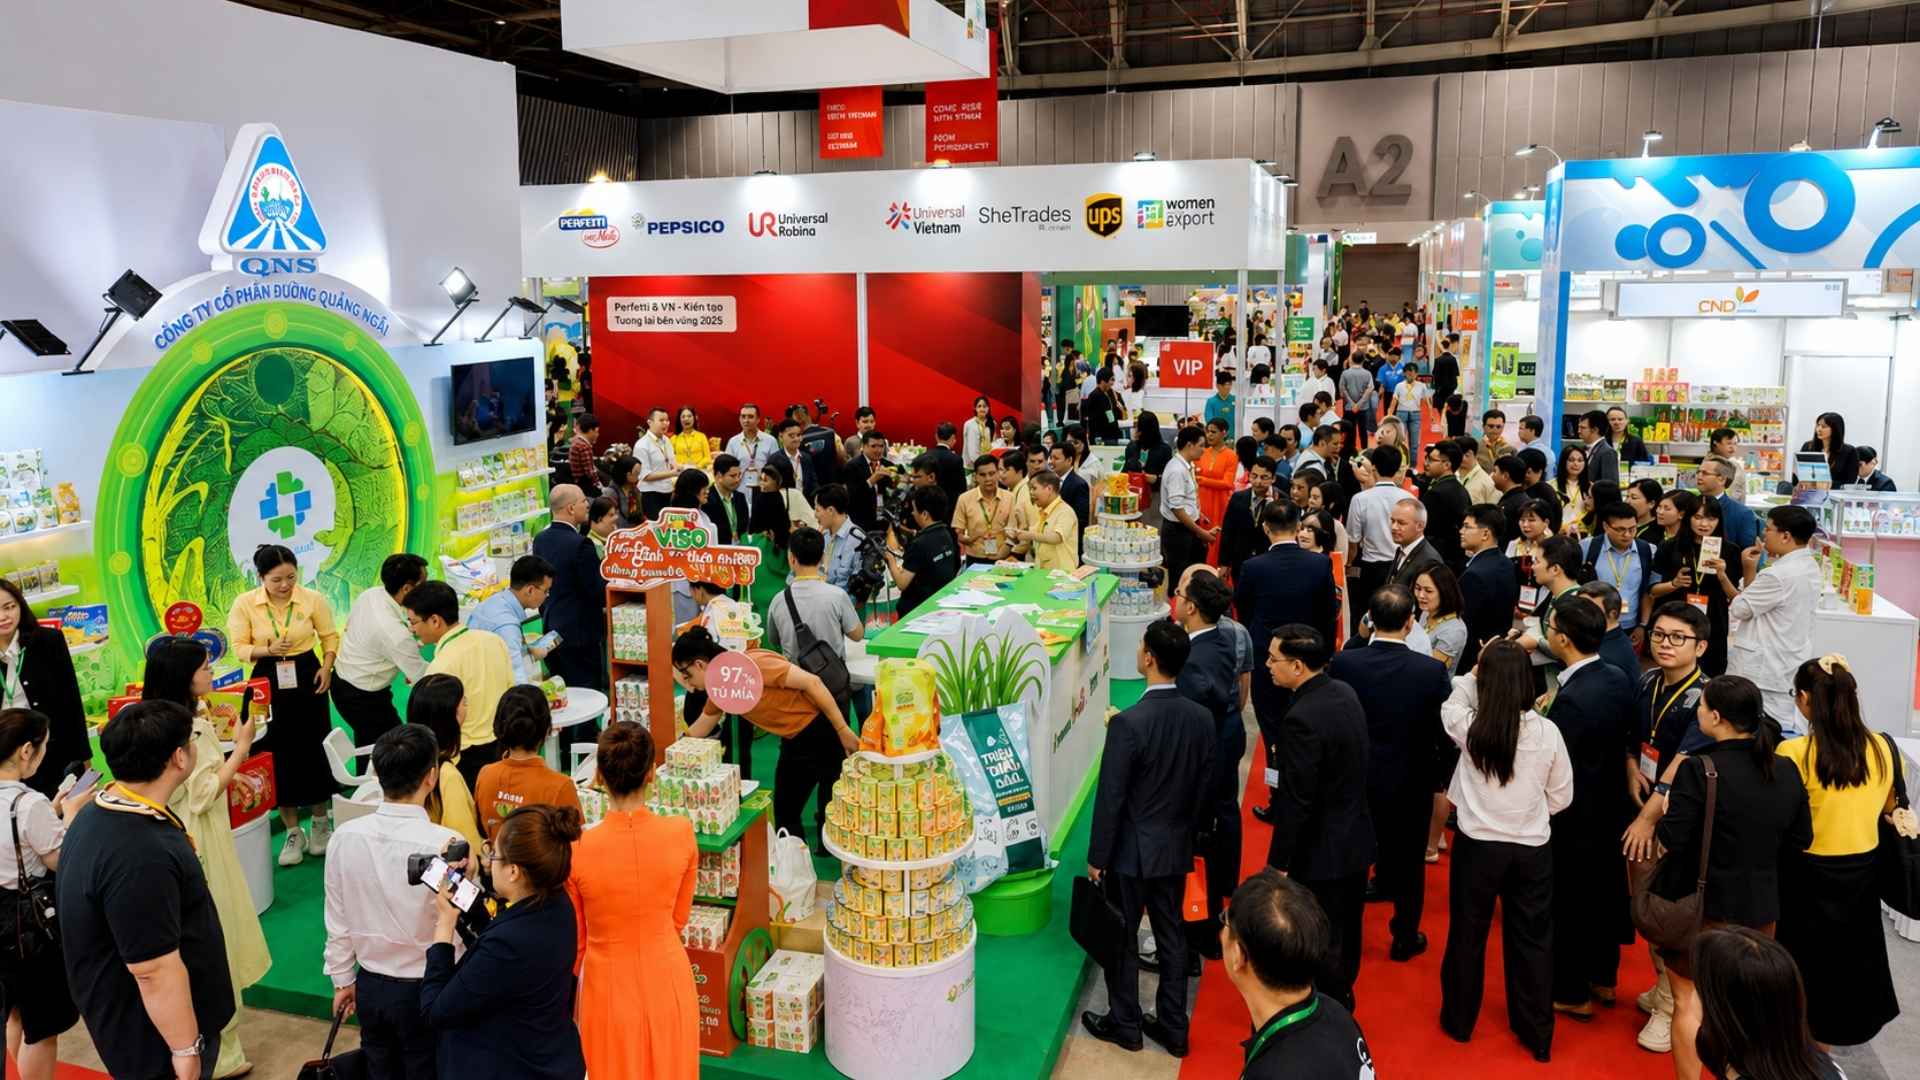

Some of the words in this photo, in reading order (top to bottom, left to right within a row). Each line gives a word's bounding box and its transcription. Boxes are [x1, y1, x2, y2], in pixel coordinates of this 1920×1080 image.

[1316, 134, 1414, 206] A2
[1166, 198, 1215, 209] women
[778, 212, 829, 225] Universal
[913, 204, 965, 220] Universal
[979, 205, 1072, 223] SheTrades
[1088, 207, 1121, 232] ups
[1166, 210, 1215, 230] export
[647, 219, 725, 235] PEPSICO
[778, 225, 816, 237] Robina
[913, 220, 961, 234] Vietnam
[240, 257, 317, 277] QNS
[191, 300, 211, 322] TY
[615, 302, 650, 311] Perfetti
[661, 302, 676, 311] VN
[1699, 300, 1737, 313] CND
[700, 315, 724, 325] 2025
[1173, 359, 1204, 376] VIP
